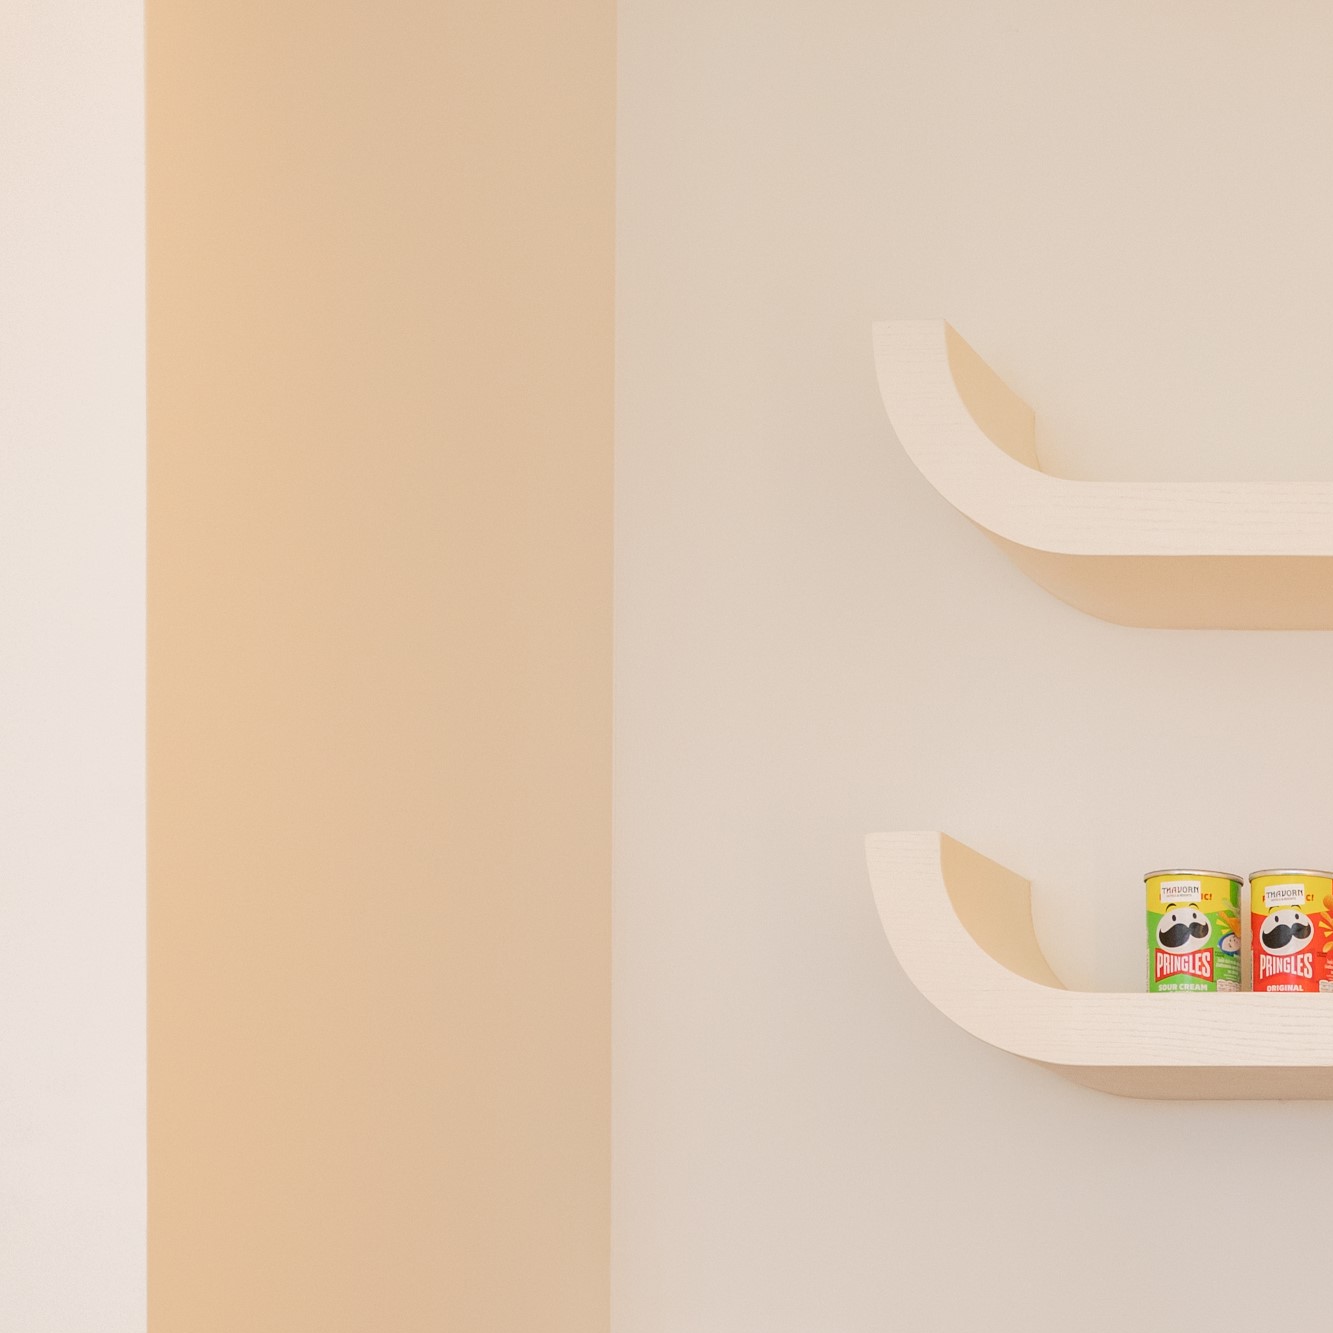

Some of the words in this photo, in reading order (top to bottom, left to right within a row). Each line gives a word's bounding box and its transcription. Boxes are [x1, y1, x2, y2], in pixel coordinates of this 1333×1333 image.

[1162, 886, 1199, 895] THAVORN
[1266, 889, 1304, 899] THAVORN
[1156, 951, 1211, 978] PRINGLES
[1260, 952, 1313, 980] PRINGLES
[1158, 984, 1178, 992] SOUR
[1179, 984, 1208, 992] CREAM
[1267, 984, 1304, 992] ORIGINAL
